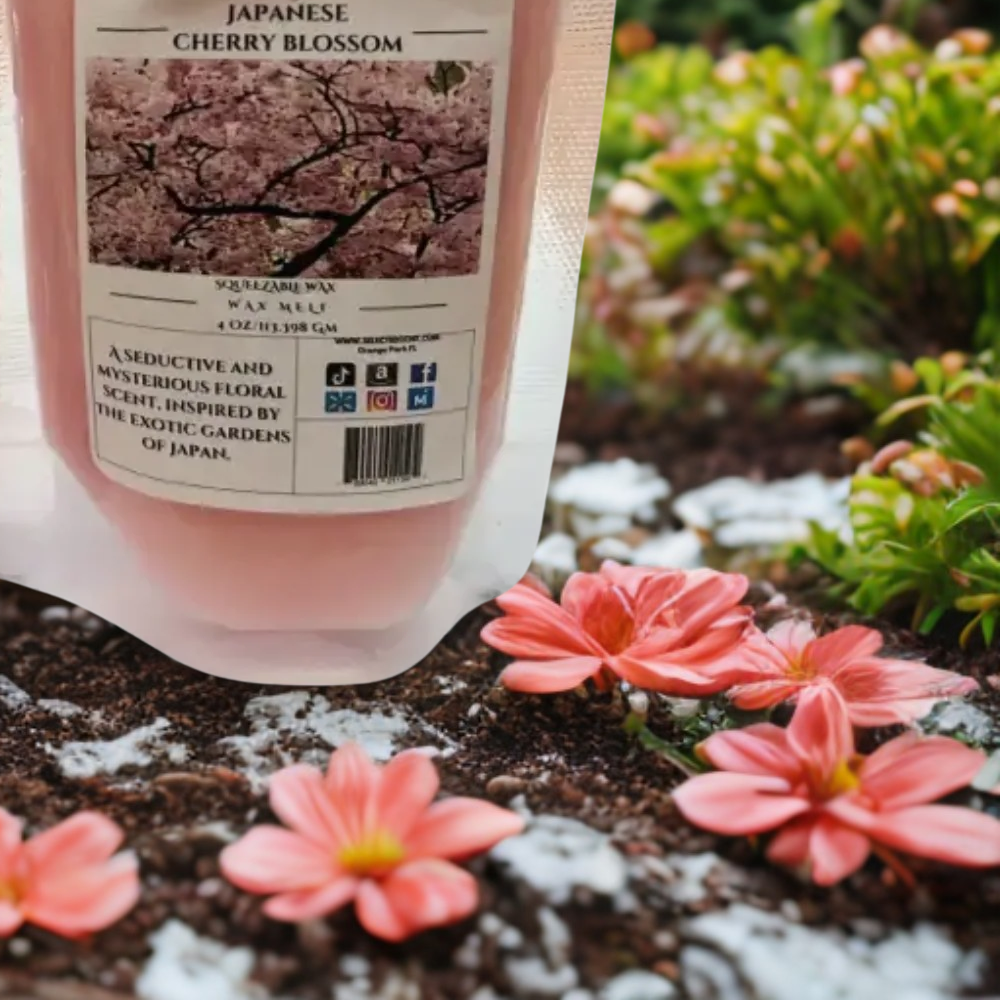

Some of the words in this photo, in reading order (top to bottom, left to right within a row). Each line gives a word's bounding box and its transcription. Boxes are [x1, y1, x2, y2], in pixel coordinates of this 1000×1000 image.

[227, 3, 349, 25] JAPANESE
[172, 33, 275, 52] CHERRY
[283, 34, 403, 53] BLOSSOM
[228, 299, 267, 313] WAX
[109, 345, 123, 363] A
[123, 349, 226, 373] SEDUCTIVE
[230, 361, 273, 376] AND
[97, 364, 210, 394] MYSTERIOUS
[214, 382, 288, 399] FLORAL
[165, 398, 253, 419] INSPIRED
[257, 407, 281, 421] BY
[95, 402, 126, 422] THE
[130, 413, 197, 436] EXOTIC
[201, 424, 291, 443] GARDENS
[142, 437, 166, 451] OF
[170, 442, 231, 460] JAPAN.
